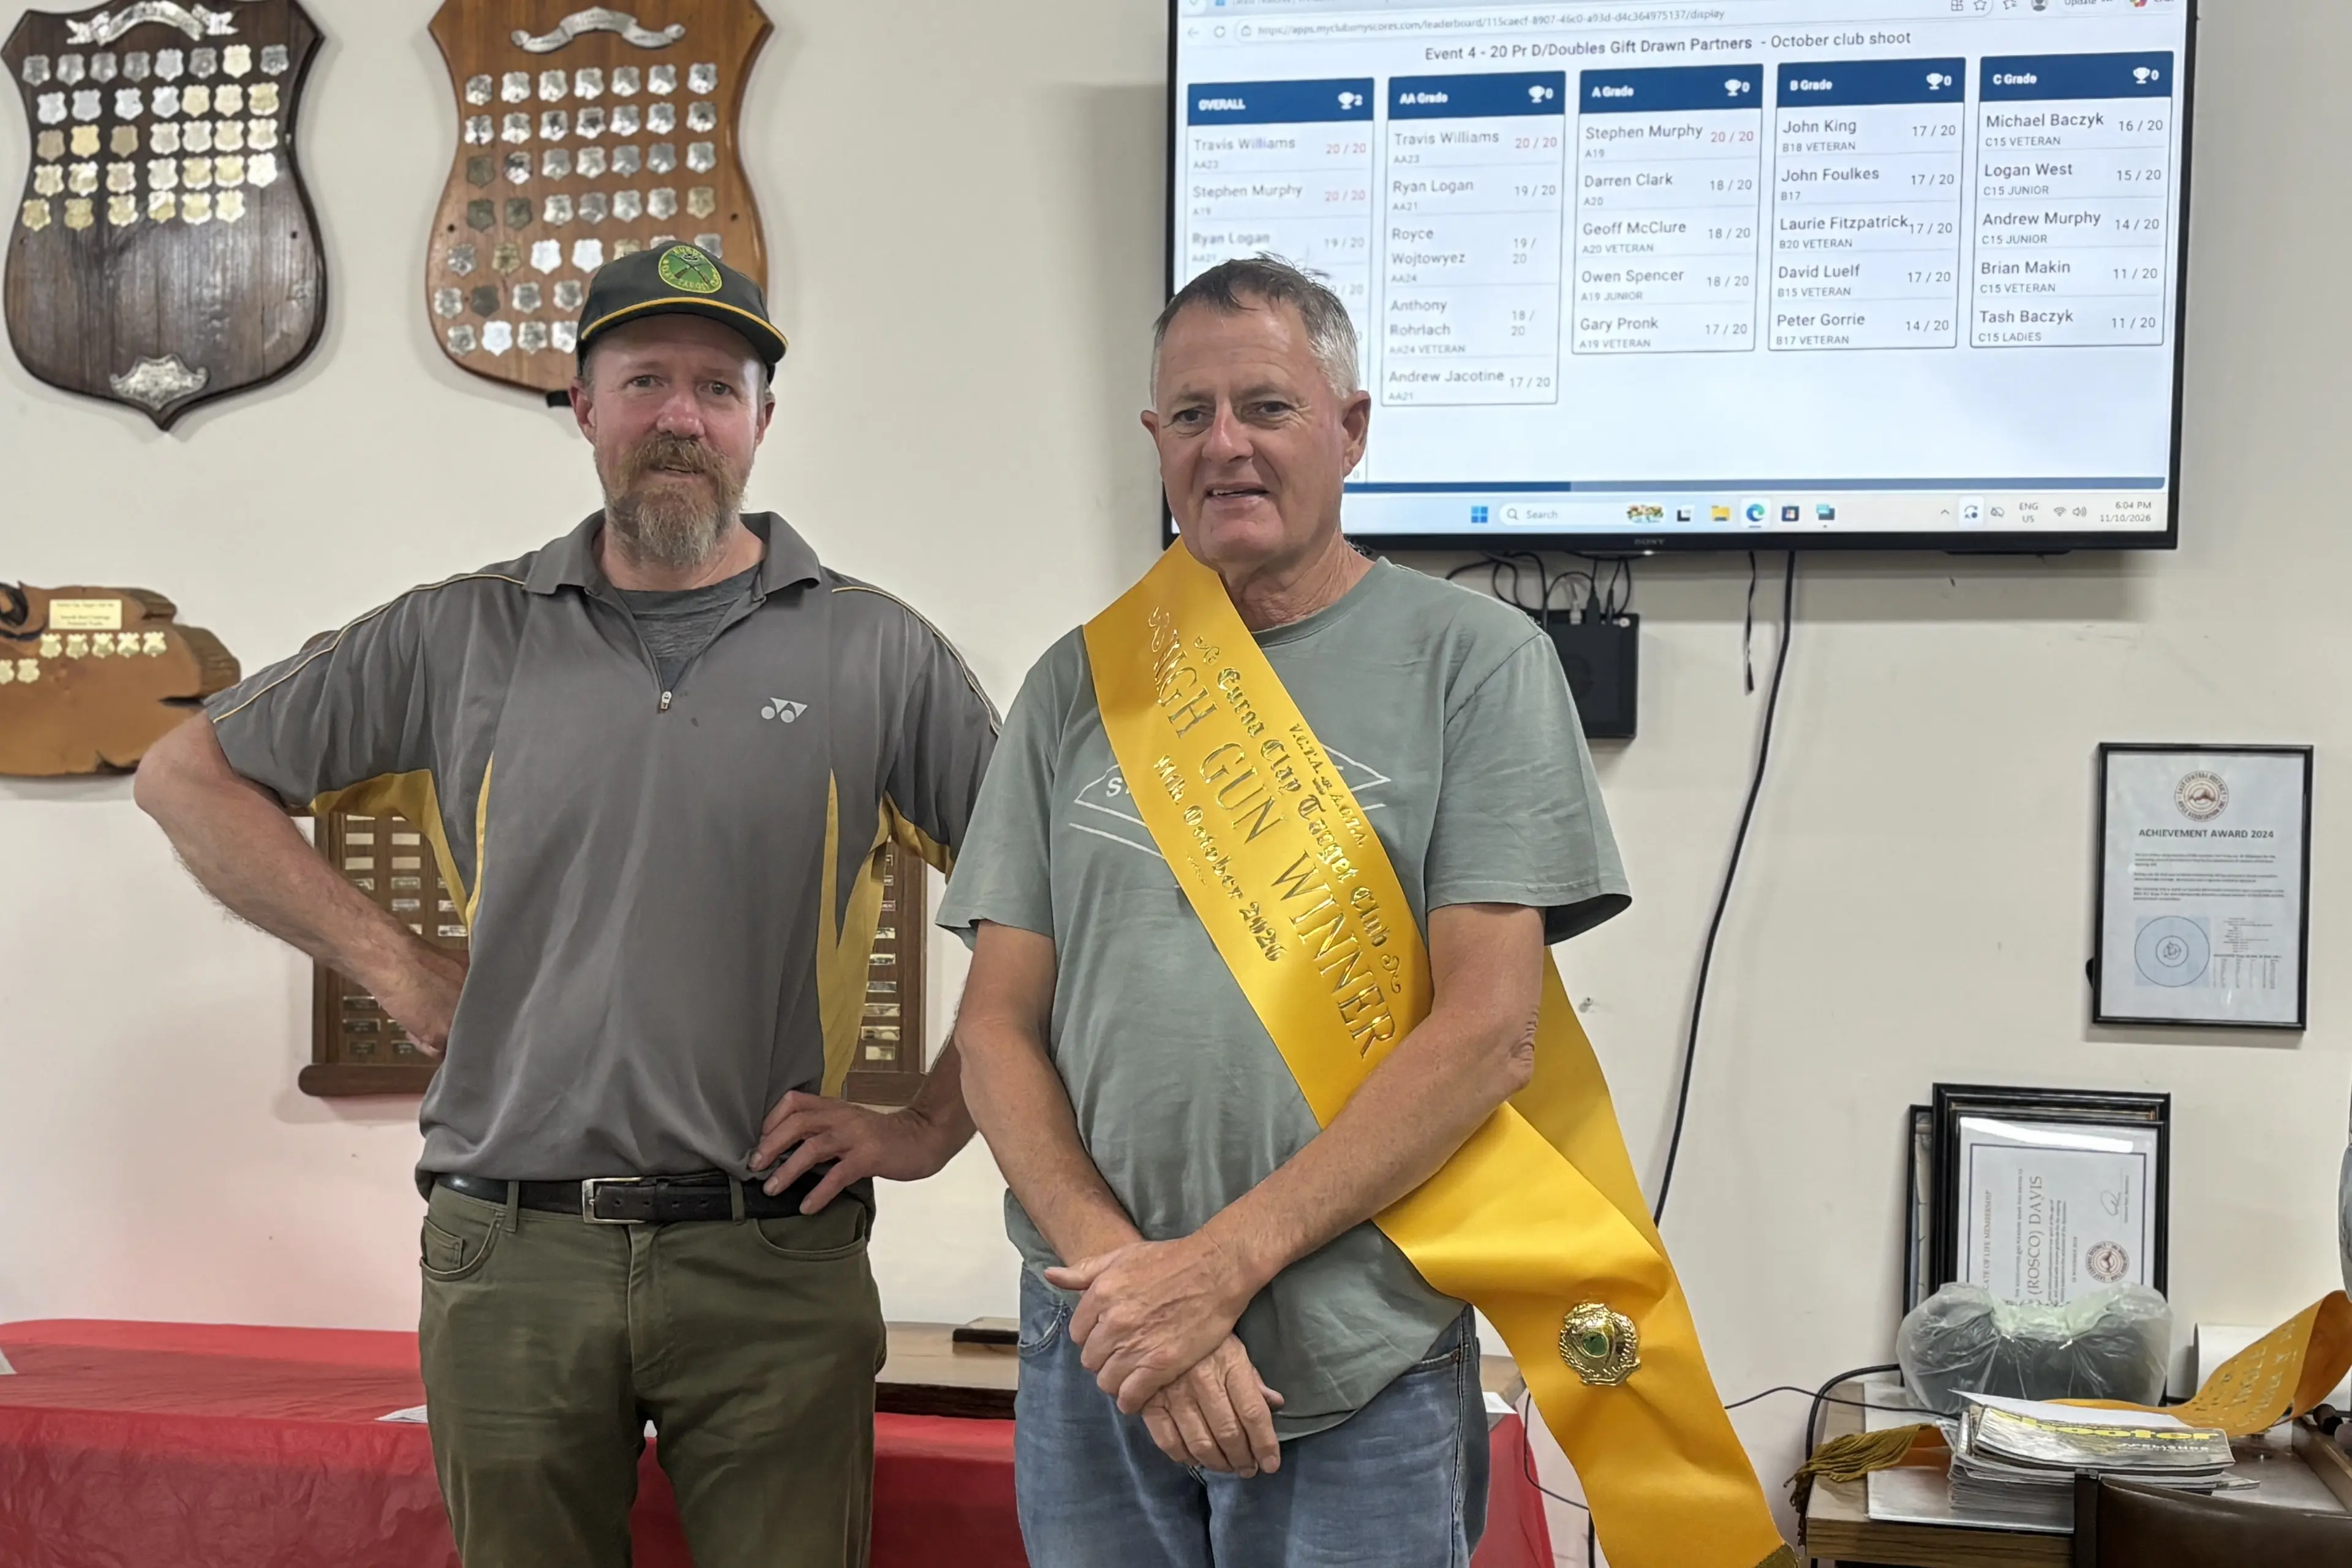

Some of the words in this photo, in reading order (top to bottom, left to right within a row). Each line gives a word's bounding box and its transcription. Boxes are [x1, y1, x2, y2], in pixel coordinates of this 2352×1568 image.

[1425, 47, 1463, 61] Event
[1468, 46, 1476, 59] 4
[1490, 45, 1508, 58] 20
[1512, 44, 1528, 58] Pr
[1531, 41, 1605, 57] D/Doubles
[1610, 39, 1637, 54] Gift
[1640, 39, 1686, 53] Drawn
[1690, 37, 1752, 51] Partners
[1771, 34, 1830, 48] October
[1833, 32, 1864, 47] club
[1869, 31, 1911, 45] shoot
[1800, 79, 1833, 91] Grade
[1993, 74, 2002, 85] C
[2004, 73, 2038, 85] Grade
[1400, 94, 1416, 104] AA
[1417, 92, 1449, 104] Grade
[1603, 86, 1634, 97] Grade
[1199, 98, 1245, 111] OVERALL
[1782, 120, 1819, 134] John
[1824, 119, 1856, 135] King
[1912, 125, 1928, 137] 17
[1940, 124, 1956, 137] 20
[1986, 113, 2045, 128] Michael
[2050, 111, 2104, 129] Baczyk
[2119, 120, 2134, 132] 16
[2147, 119, 2163, 131] 20
[1586, 126, 1644, 141] Stephen
[1649, 123, 1703, 140] Murphy
[1711, 131, 1725, 143] 20
[1739, 130, 1754, 141] 20
[1195, 139, 1234, 151] Travis
[1239, 138, 1295, 149] Williams
[1395, 133, 1436, 146] Travis
[1440, 132, 1499, 143] Williams
[1515, 138, 1529, 149] 20
[1543, 137, 1557, 148] 20
[1782, 143, 1803, 153] B18
[1806, 141, 1856, 152] VETERAN
[1985, 137, 2007, 148] C15
[2009, 136, 2061, 146] VETERAN
[1781, 168, 1817, 183] John
[1822, 167, 1880, 181] Foulkes
[1911, 174, 1926, 186] 17
[1939, 173, 1954, 185] 20
[1984, 164, 2030, 180] Logan
[2035, 162, 2073, 176] West
[2117, 170, 2132, 181] 15
[2146, 169, 2162, 181] 20
[1393, 180, 1427, 195] Ryan
[1431, 180, 1474, 194] Logan
[1515, 186, 1528, 196] 19
[1541, 184, 1556, 196] 20
[1584, 175, 1631, 188] Darren
[1636, 172, 1673, 186] Clark
[1710, 179, 1724, 191] 18
[1737, 179, 1752, 190] 20
[1193, 186, 1247, 198] Stephen
[1252, 184, 1303, 198] Murphy
[1781, 190, 1801, 201] B17
[1983, 186, 2005, 196] C15
[2007, 185, 2049, 195] JUNIOR
[1780, 217, 1826, 231] Laurie
[1830, 215, 1908, 233] Fitzpatrick
[1937, 222, 1953, 234] 20
[1982, 212, 2040, 226] Andrew
[2044, 211, 2101, 227] Murphy
[2115, 219, 2130, 230] 14
[2144, 218, 2160, 230] 20
[1392, 228, 1434, 243] Royce
[1583, 221, 1623, 236] Geoff
[1627, 221, 1686, 234] McClure
[1708, 228, 1722, 239] 18
[1735, 227, 1751, 239] 20
[1803, 238, 1853, 249] VETERAN
[1981, 235, 2003, 245] C15
[2005, 234, 2048, 244] JUNIOR
[1513, 254, 1527, 265] 20
[1778, 265, 1819, 279] David
[1823, 263, 1860, 278] Luelf
[1907, 271, 1922, 283] 17
[1936, 271, 1951, 282] 20
[1981, 261, 2020, 275] Brian
[2025, 260, 2071, 274] Makin
[2113, 268, 2127, 280] 11
[2142, 268, 2158, 279] 20
[1581, 270, 1621, 283] Owen
[1626, 270, 1684, 285] Spencer
[1706, 276, 1721, 287] 18
[1734, 276, 1749, 287] 20
[1777, 287, 1798, 298] B15
[1801, 287, 1851, 297] VETERAN
[1980, 284, 2002, 294] C15
[2003, 283, 2056, 293] VETERAN
[1390, 300, 1447, 314] Anthony
[1580, 317, 1613, 333] Gary
[1617, 317, 1659, 330] Pronk
[1705, 323, 1719, 335] 17
[1732, 323, 1747, 335] 20
[1777, 314, 1816, 327] Peter
[1820, 313, 1866, 326] Gorrie
[1905, 320, 1920, 331] 14
[1934, 320, 1949, 331] 20
[1979, 309, 2015, 323] Tash
[2019, 309, 2074, 325] Baczyk
[2111, 317, 2125, 329] 11
[2140, 317, 2156, 328] 20
[1390, 323, 1450, 336] Rohrlach
[1978, 333, 1999, 342] C15
[2002, 331, 2041, 342] LADIES
[1579, 339, 1599, 349] A19
[1603, 339, 1651, 349] VETERAN
[1776, 336, 1796, 345] B17
[1799, 335, 1849, 345] VETERAN
[1389, 371, 1441, 382] Andrew
[1445, 370, 1504, 382] Jacotine
[1510, 377, 1524, 388] 17
[1536, 377, 1551, 388] 20
[2019, 502, 2038, 511] ENG
[1526, 510, 1558, 521] Search
[2100, 514, 2151, 522] 11/10/2026
[2139, 829, 2208, 838] ACHIEVEMENT
[2211, 829, 2248, 838] AWARD
[2251, 829, 2274, 839] 2024
[1260, 739, 1302, 796] Clay
[1350, 886, 1390, 948] Club
[1183, 805, 1244, 900] October
[1238, 901, 1287, 962] 2026
[1199, 742, 1286, 845] GUN
[1270, 850, 1397, 1060] WINNER
[2029, 1175, 2043, 1225] DAVIS
[2027, 1230, 2045, 1295] (ROSCO)
